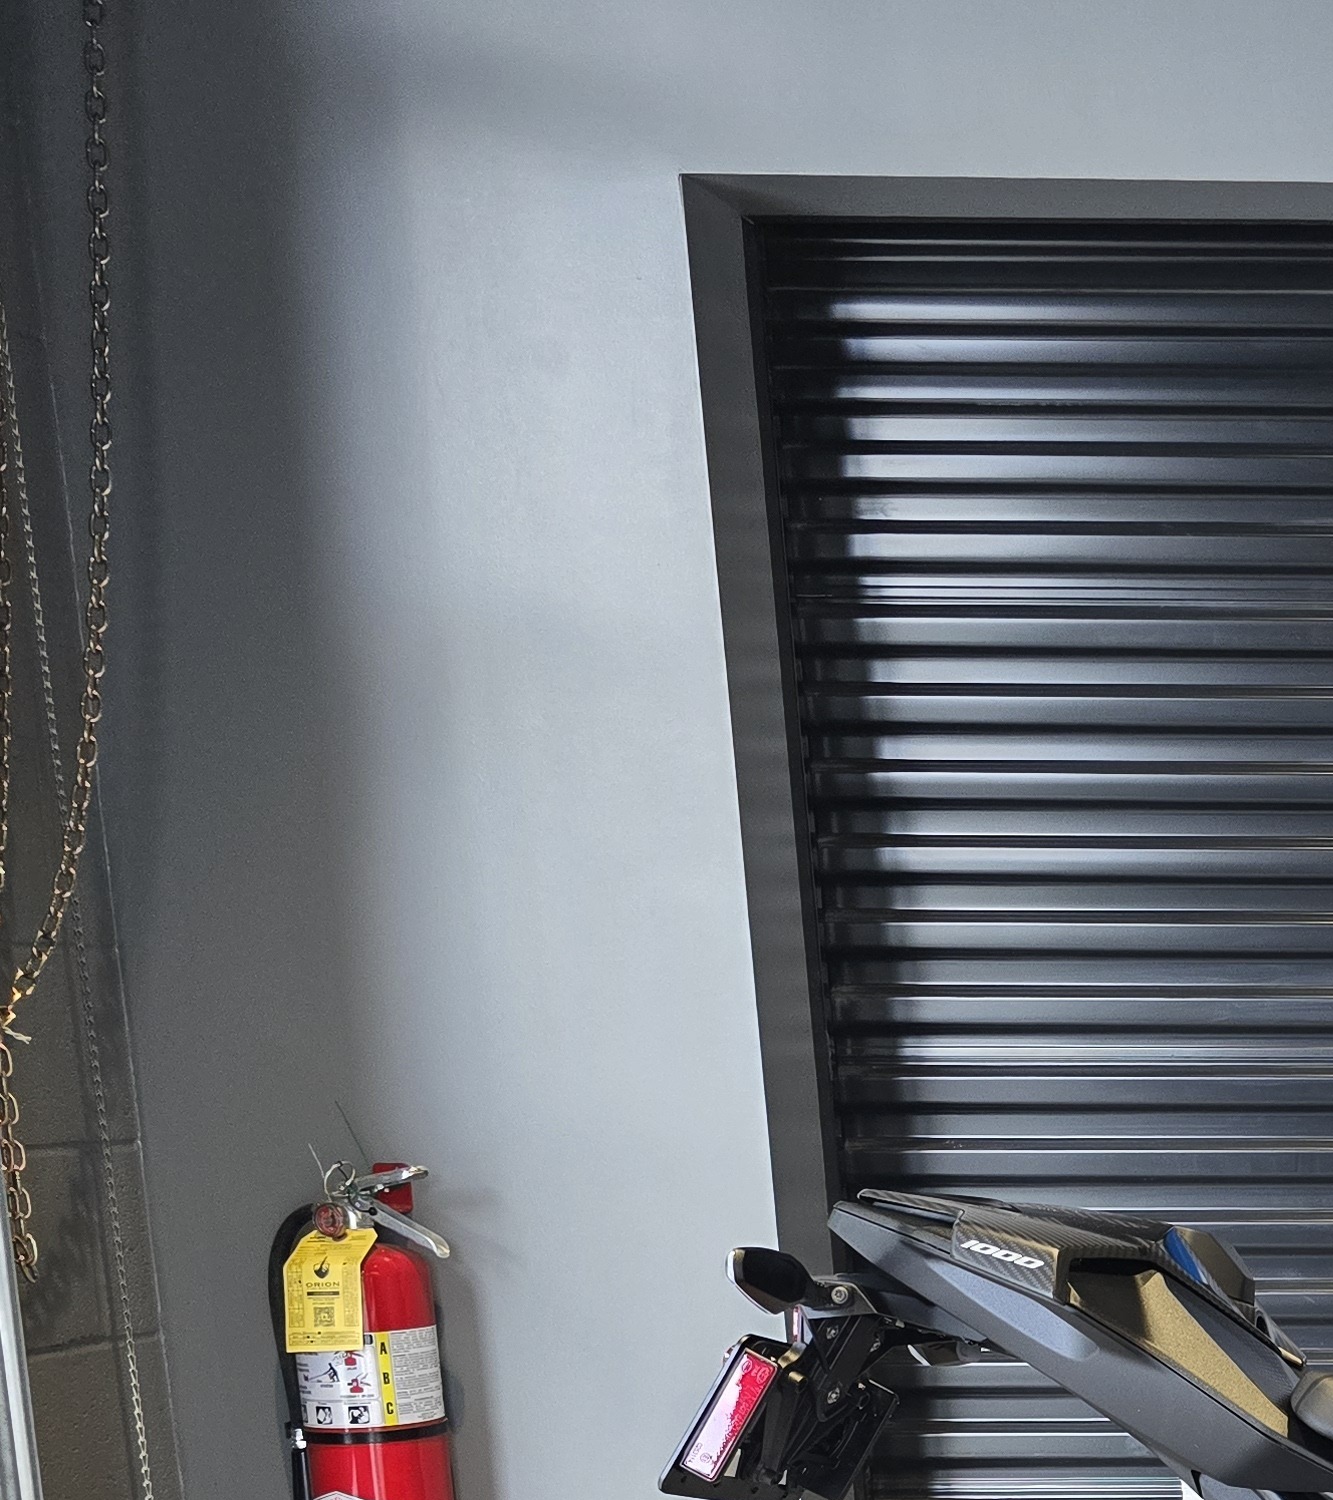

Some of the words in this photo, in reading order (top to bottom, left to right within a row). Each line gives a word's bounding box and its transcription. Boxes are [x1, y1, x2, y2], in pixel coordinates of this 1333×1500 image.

[960, 1239, 1045, 1269] 1000
[379, 1342, 388, 1355] A
[382, 1372, 391, 1385] B
[386, 1402, 394, 1415] C
